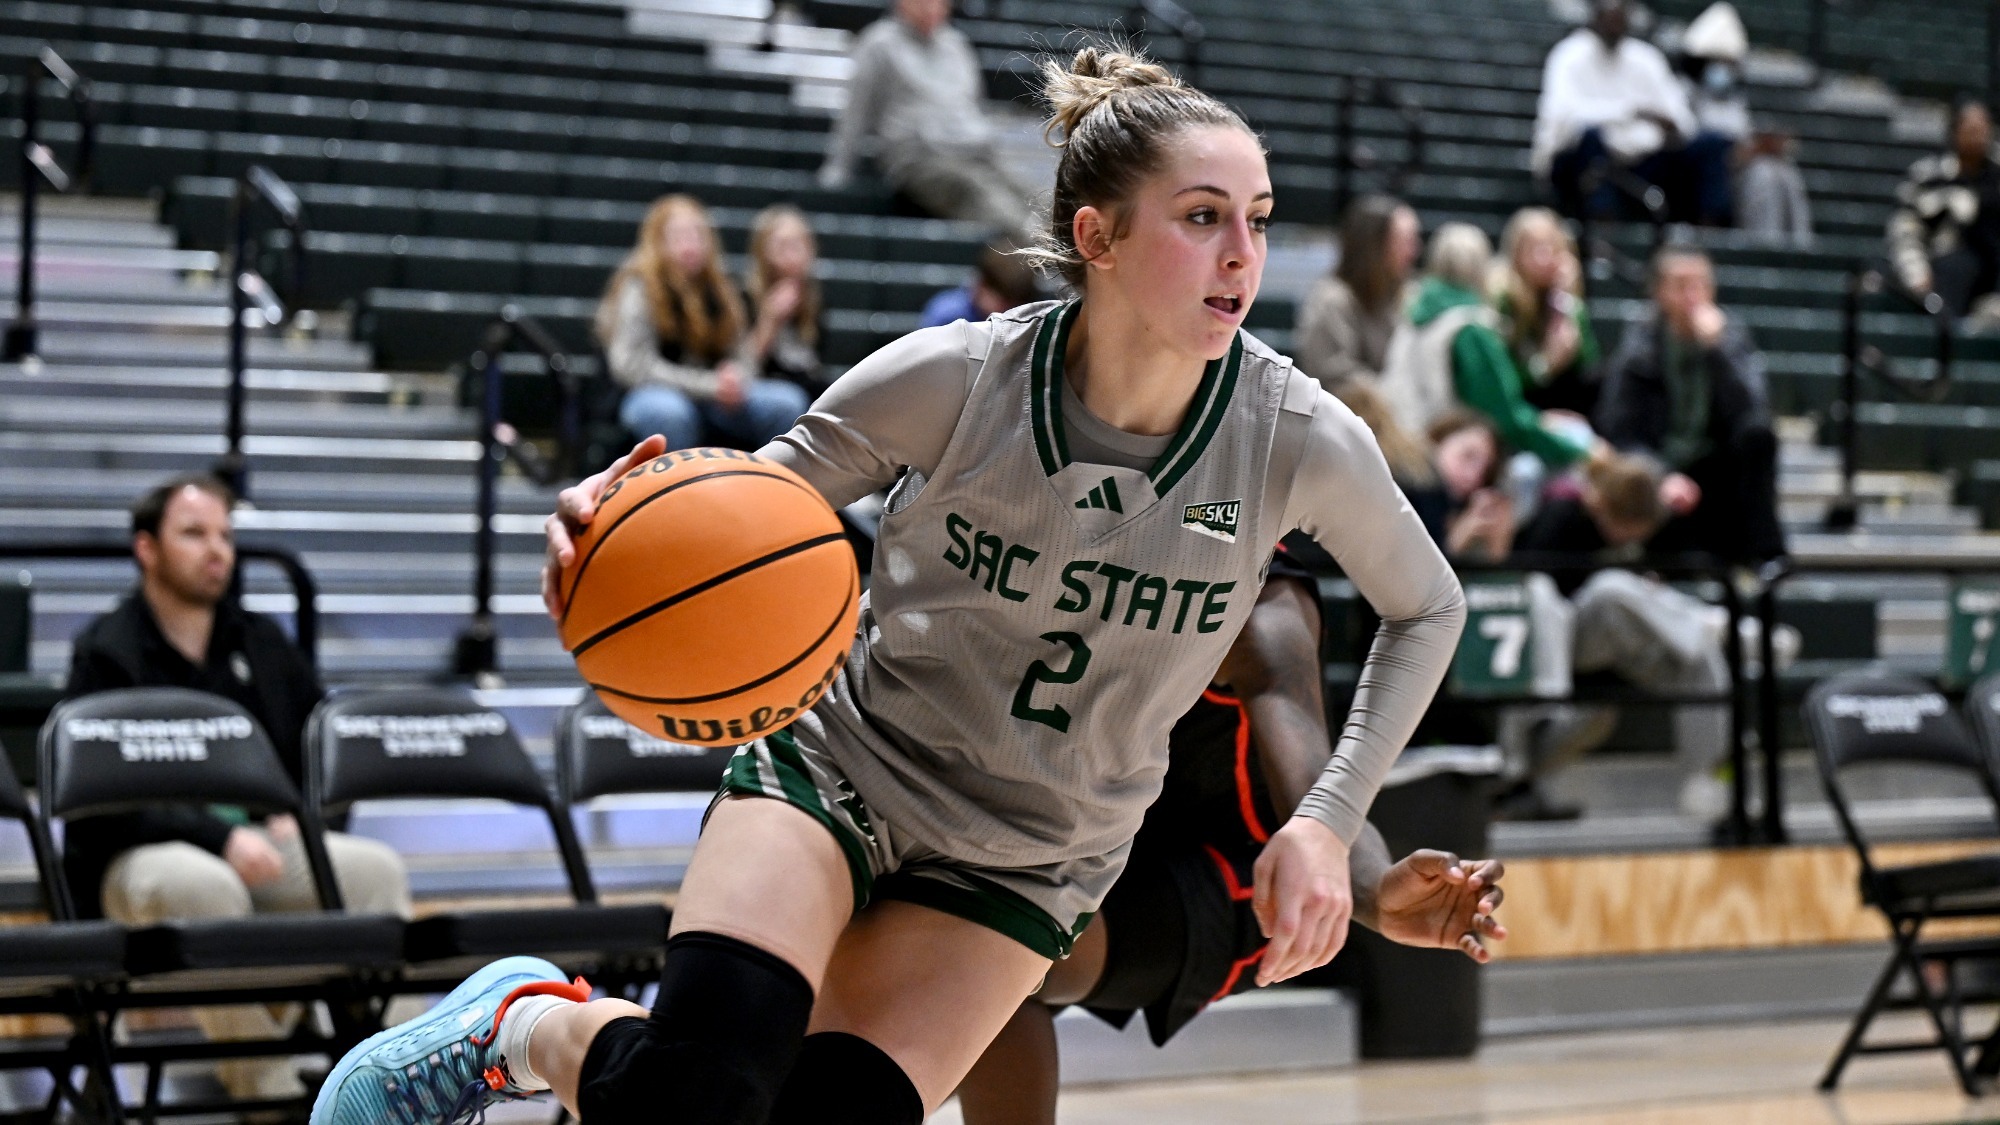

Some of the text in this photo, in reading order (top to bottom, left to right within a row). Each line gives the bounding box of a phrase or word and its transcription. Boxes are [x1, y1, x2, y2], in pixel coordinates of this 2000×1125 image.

[942, 512, 1237, 634] SAC STATE
[1010, 631, 1092, 733] 2
[1478, 615, 1527, 678] 7
[656, 650, 849, 741] Wilson
